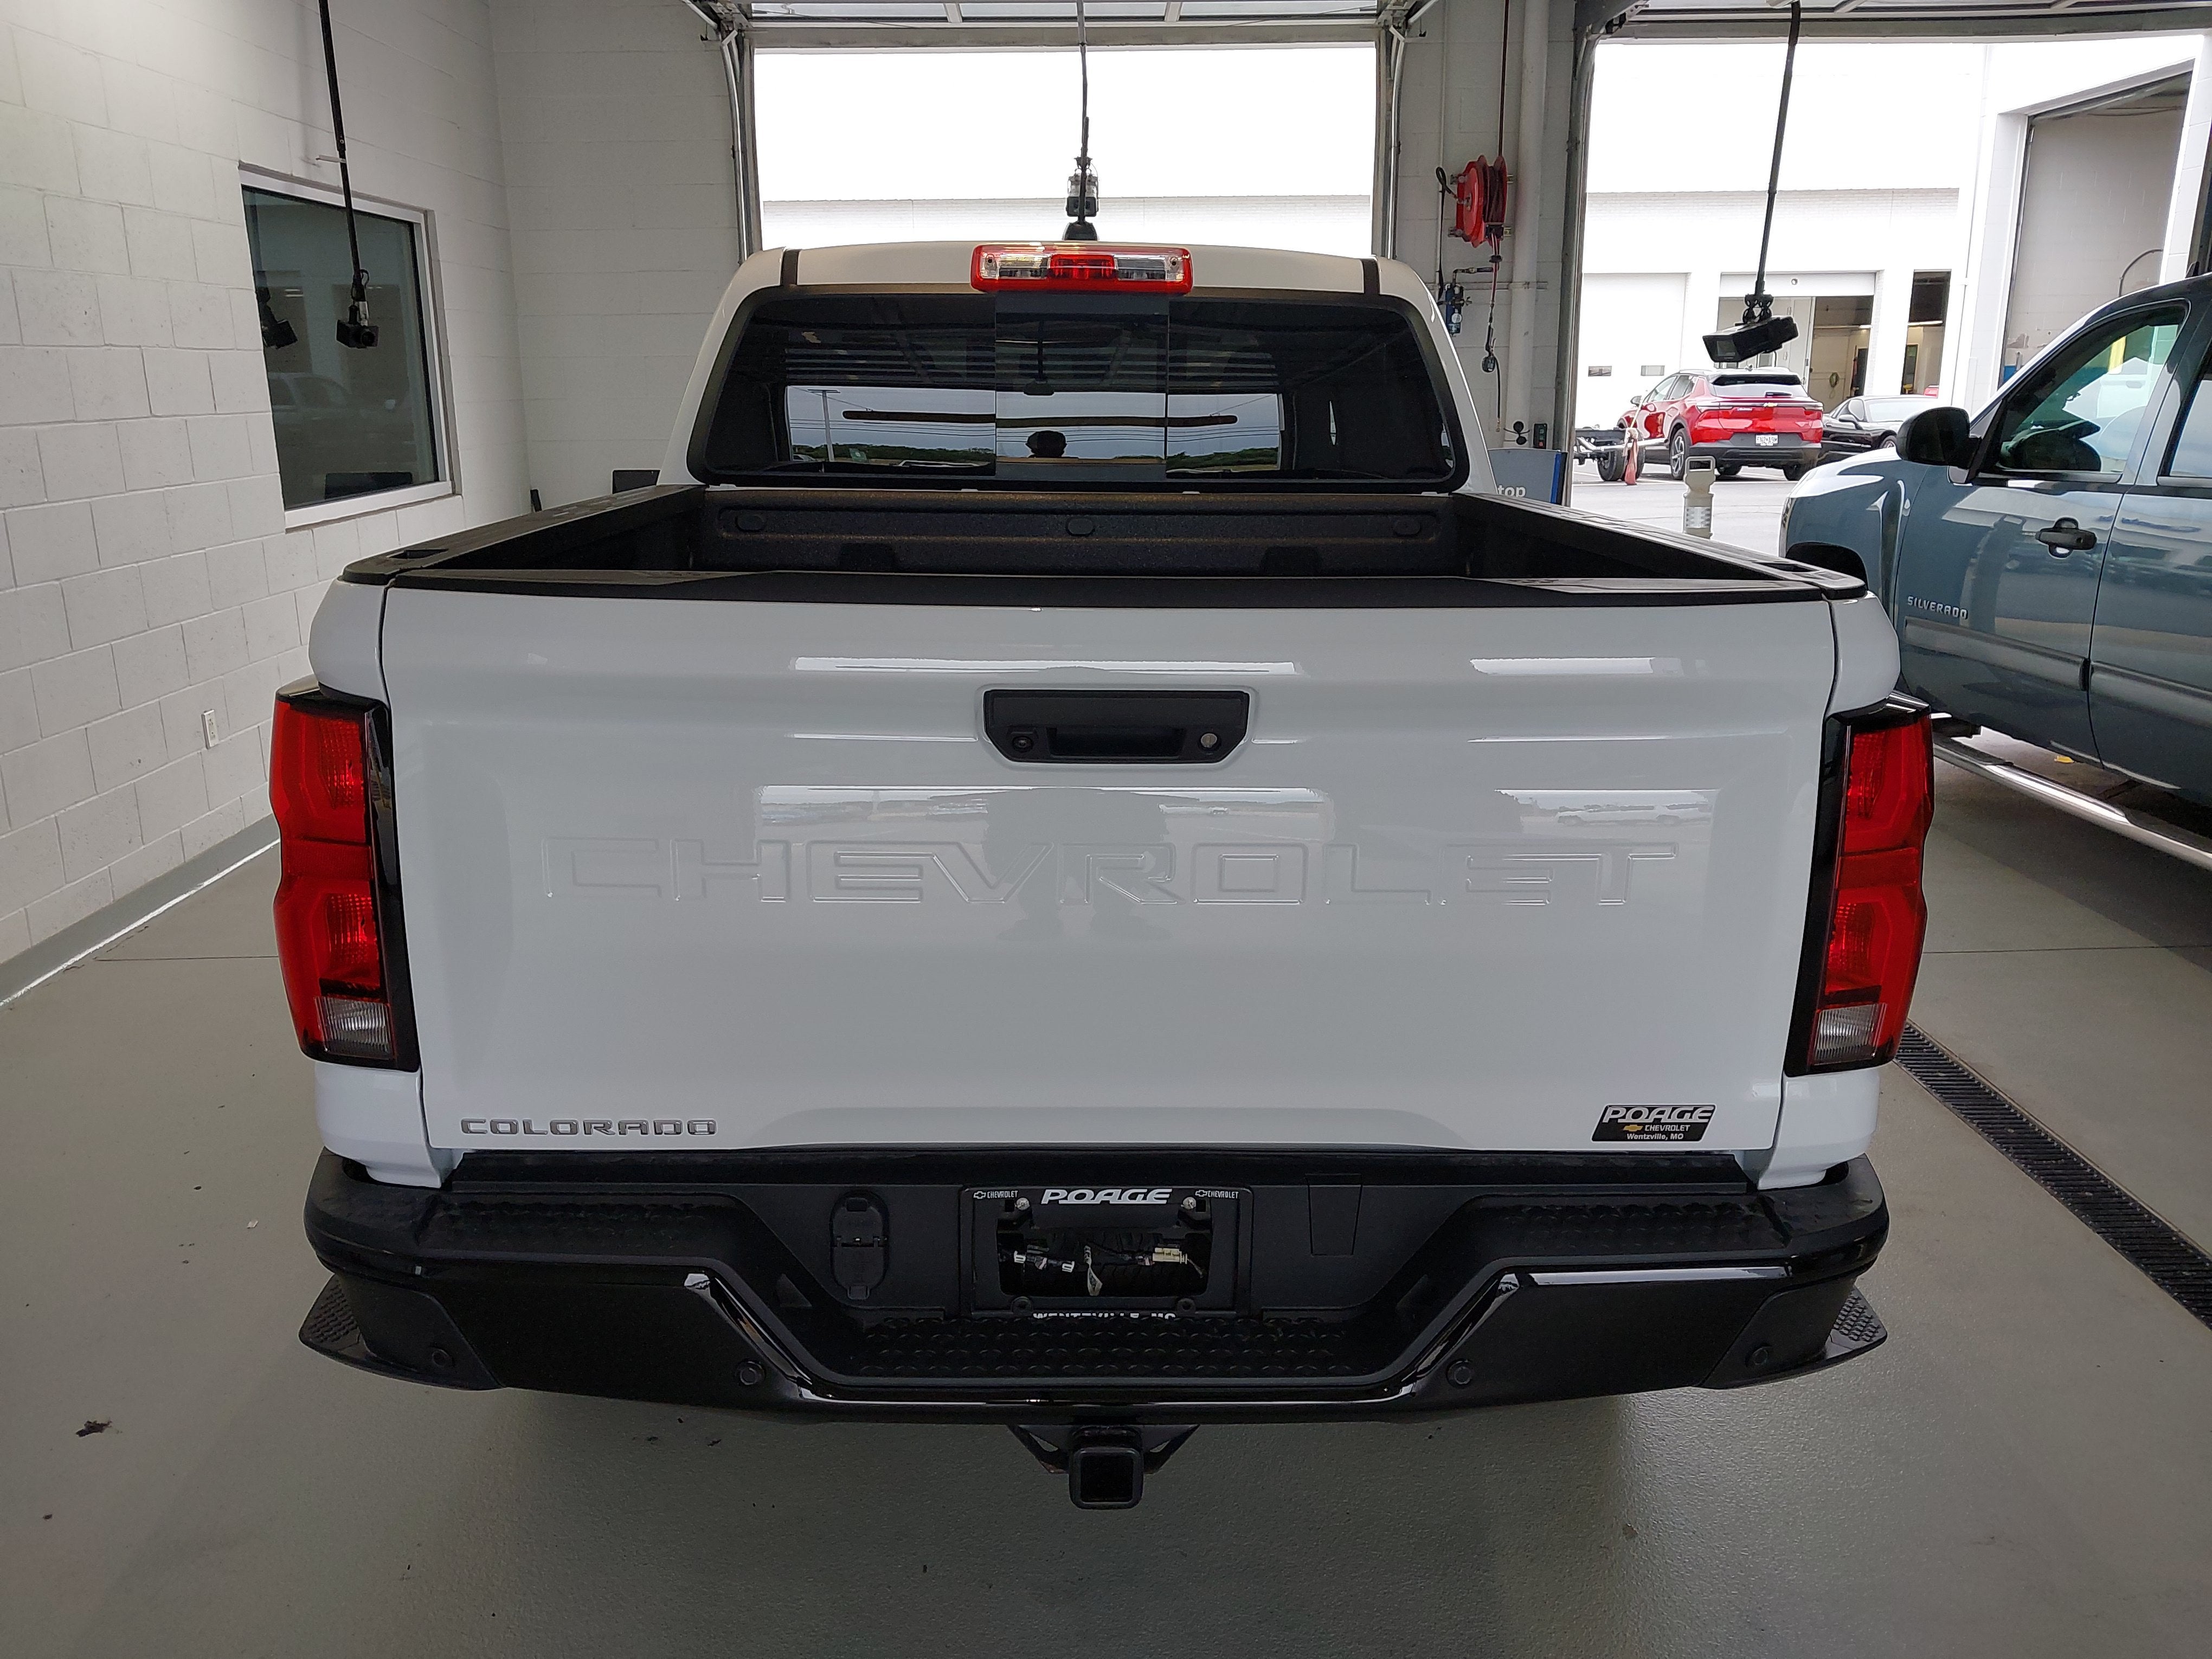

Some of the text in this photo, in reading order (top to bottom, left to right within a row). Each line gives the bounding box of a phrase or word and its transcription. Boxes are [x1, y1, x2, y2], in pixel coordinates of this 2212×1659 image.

[1907, 596, 1968, 620] SILVERADO
[541, 837, 1679, 904] CHEVROLET
[1602, 1105, 1715, 1123] POAGE
[461, 1118, 718, 1136] COLORADO
[987, 1190, 1019, 1199] CHEVROLET
[1040, 1188, 1173, 1205] POAGE
[1207, 1190, 1239, 1199] CHEVROLET
